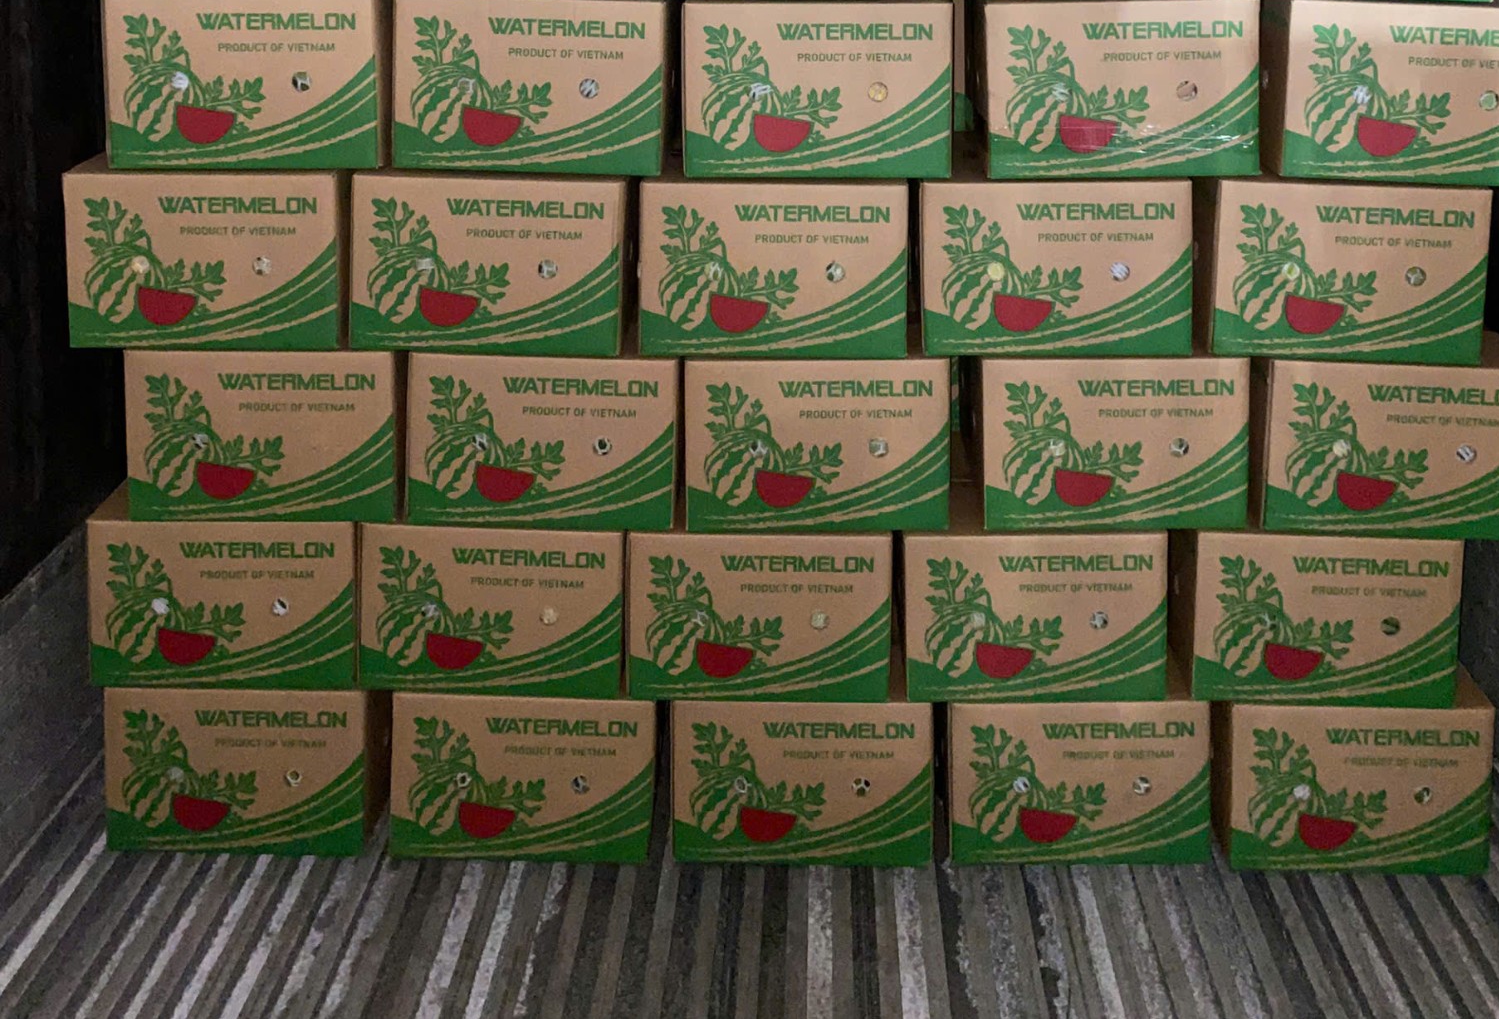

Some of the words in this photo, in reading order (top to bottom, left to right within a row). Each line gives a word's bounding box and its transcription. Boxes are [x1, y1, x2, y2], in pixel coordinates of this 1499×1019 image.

[196, 13, 356, 30] WATERMELON
[488, 17, 645, 39] WATERMELON
[777, 23, 933, 40] WATERMELON
[1082, 21, 1243, 40] WATERMELON
[507, 47, 557, 59] PRODUCT
[560, 49, 574, 59] OF
[576, 49, 624, 60] VIETNAM
[796, 52, 846, 63] PRODUCT
[848, 52, 862, 62] OF
[865, 52, 912, 63] VIETNAM
[1102, 51, 1154, 62] PRODUCT
[1156, 51, 1170, 61] OF
[1173, 50, 1222, 61] VIETNAM
[158, 197, 317, 214] WATERMELON
[447, 198, 604, 219] WATERMELON
[735, 205, 890, 223] WATERMELON
[1017, 203, 1175, 220] WATERMELON
[1317, 206, 1475, 229] WATERMELON
[754, 234, 803, 244] PRODUCT
[805, 234, 819, 244] OF
[822, 234, 870, 245] VIETNAM
[218, 373, 375, 390] WATERMELON
[503, 377, 658, 397] WATERMELON
[779, 380, 932, 398] WATERMELON
[1078, 379, 1234, 397] WATERMELON
[522, 405, 572, 416] PRODUCT
[573, 407, 586, 417] OF
[590, 408, 637, 418] VIETNAM
[179, 542, 334, 559] WATERMELON
[452, 548, 605, 569] WATERMELON
[721, 555, 874, 573] WATERMELON
[999, 555, 1153, 572] WATERMELON
[1293, 557, 1450, 577] WATERMELON
[195, 710, 347, 728] WATERMELON
[486, 718, 637, 737] WATERMELON
[763, 722, 914, 739] WATERMELON
[1042, 723, 1195, 739] WATERMELON
[1326, 729, 1480, 748] WATERMELON
